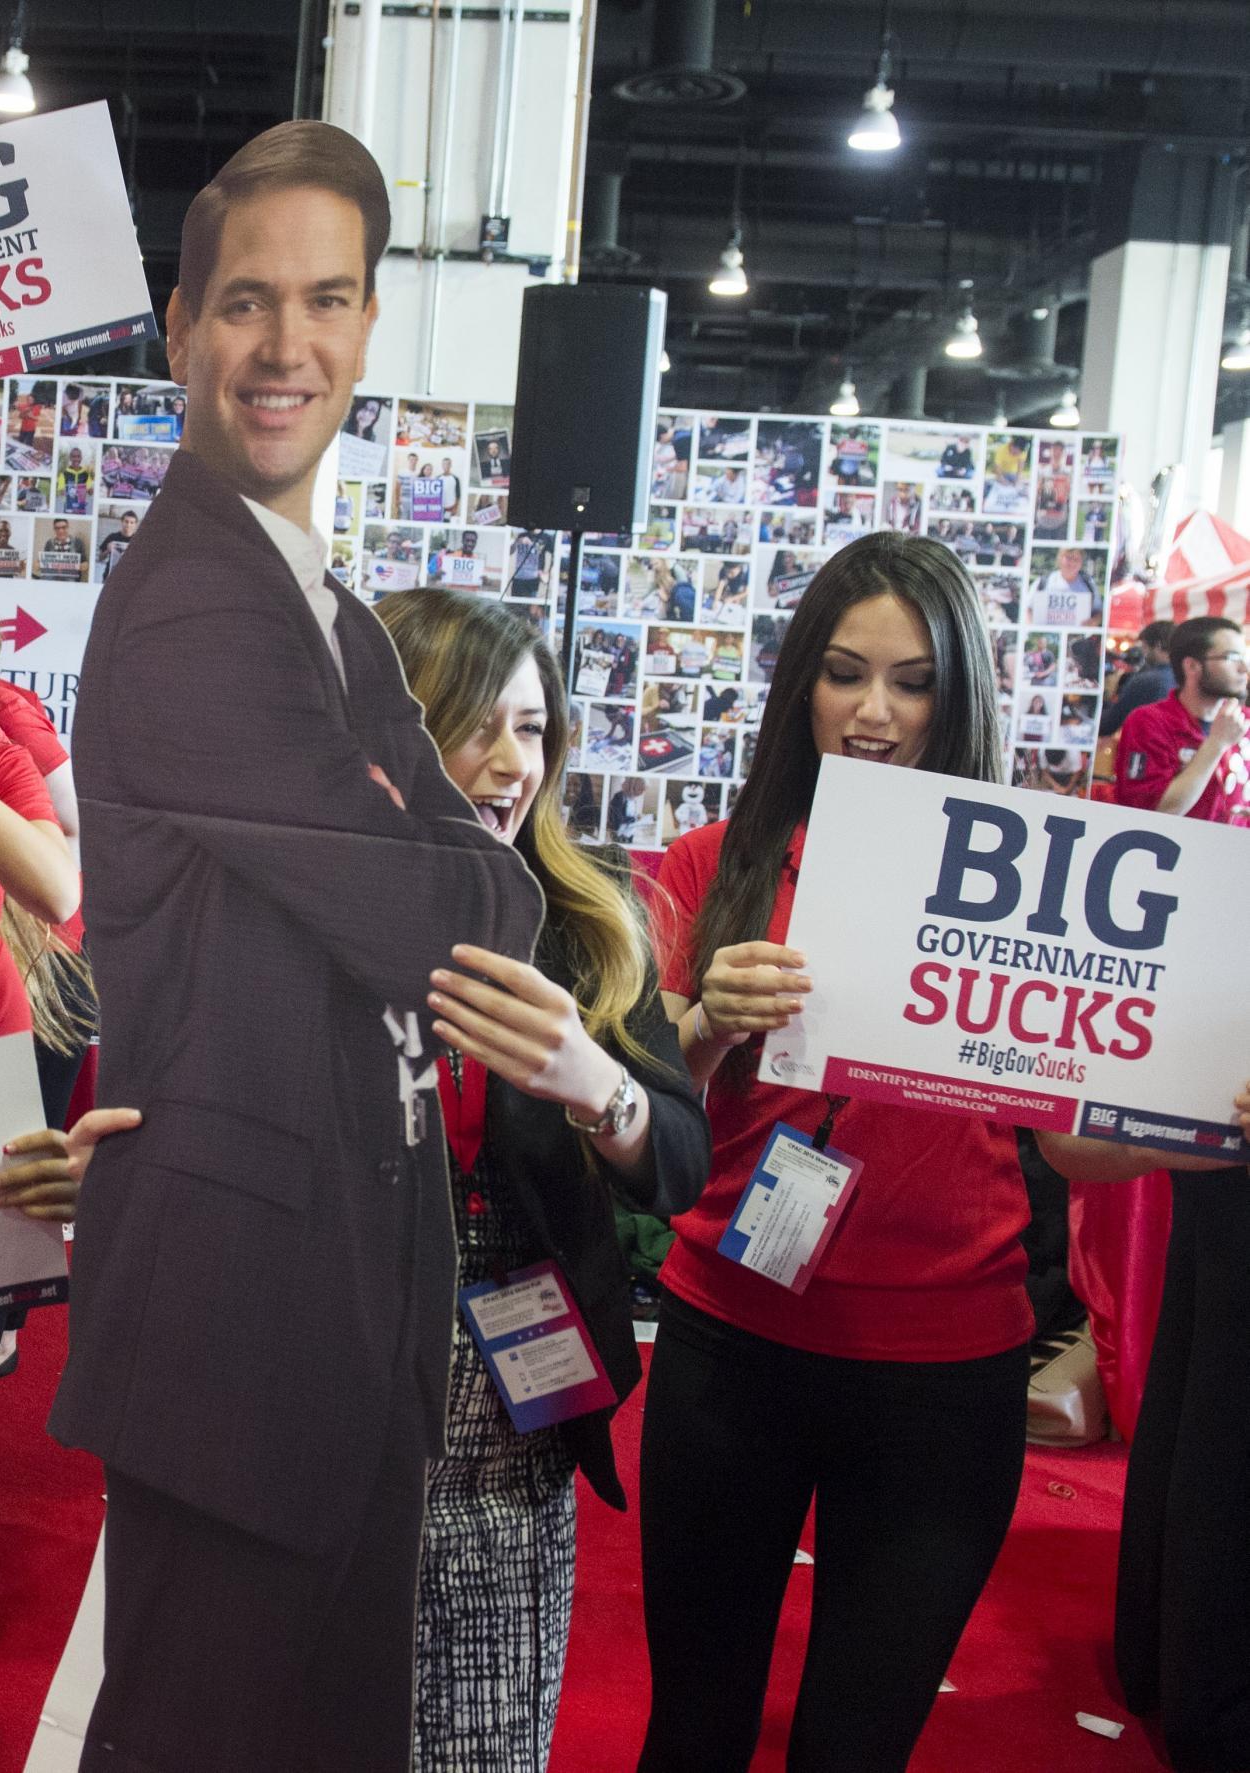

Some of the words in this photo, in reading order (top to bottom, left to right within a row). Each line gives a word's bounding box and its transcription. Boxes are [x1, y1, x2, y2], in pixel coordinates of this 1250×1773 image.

[29, 342, 50, 360] BIG
[414, 481, 442, 494] BIG
[453, 559, 474, 571] BIG
[924, 795, 1183, 950] BIG
[916, 924, 1166, 991] GOVERNMENT
[902, 961, 1156, 1060] SUCKS
[958, 1039, 1087, 1083] #BigGovSucks
[916, 1079, 982, 1100] EMPOWER
[988, 1091, 1056, 1113] ORGANIZE
[1088, 1106, 1116, 1125] BIG
